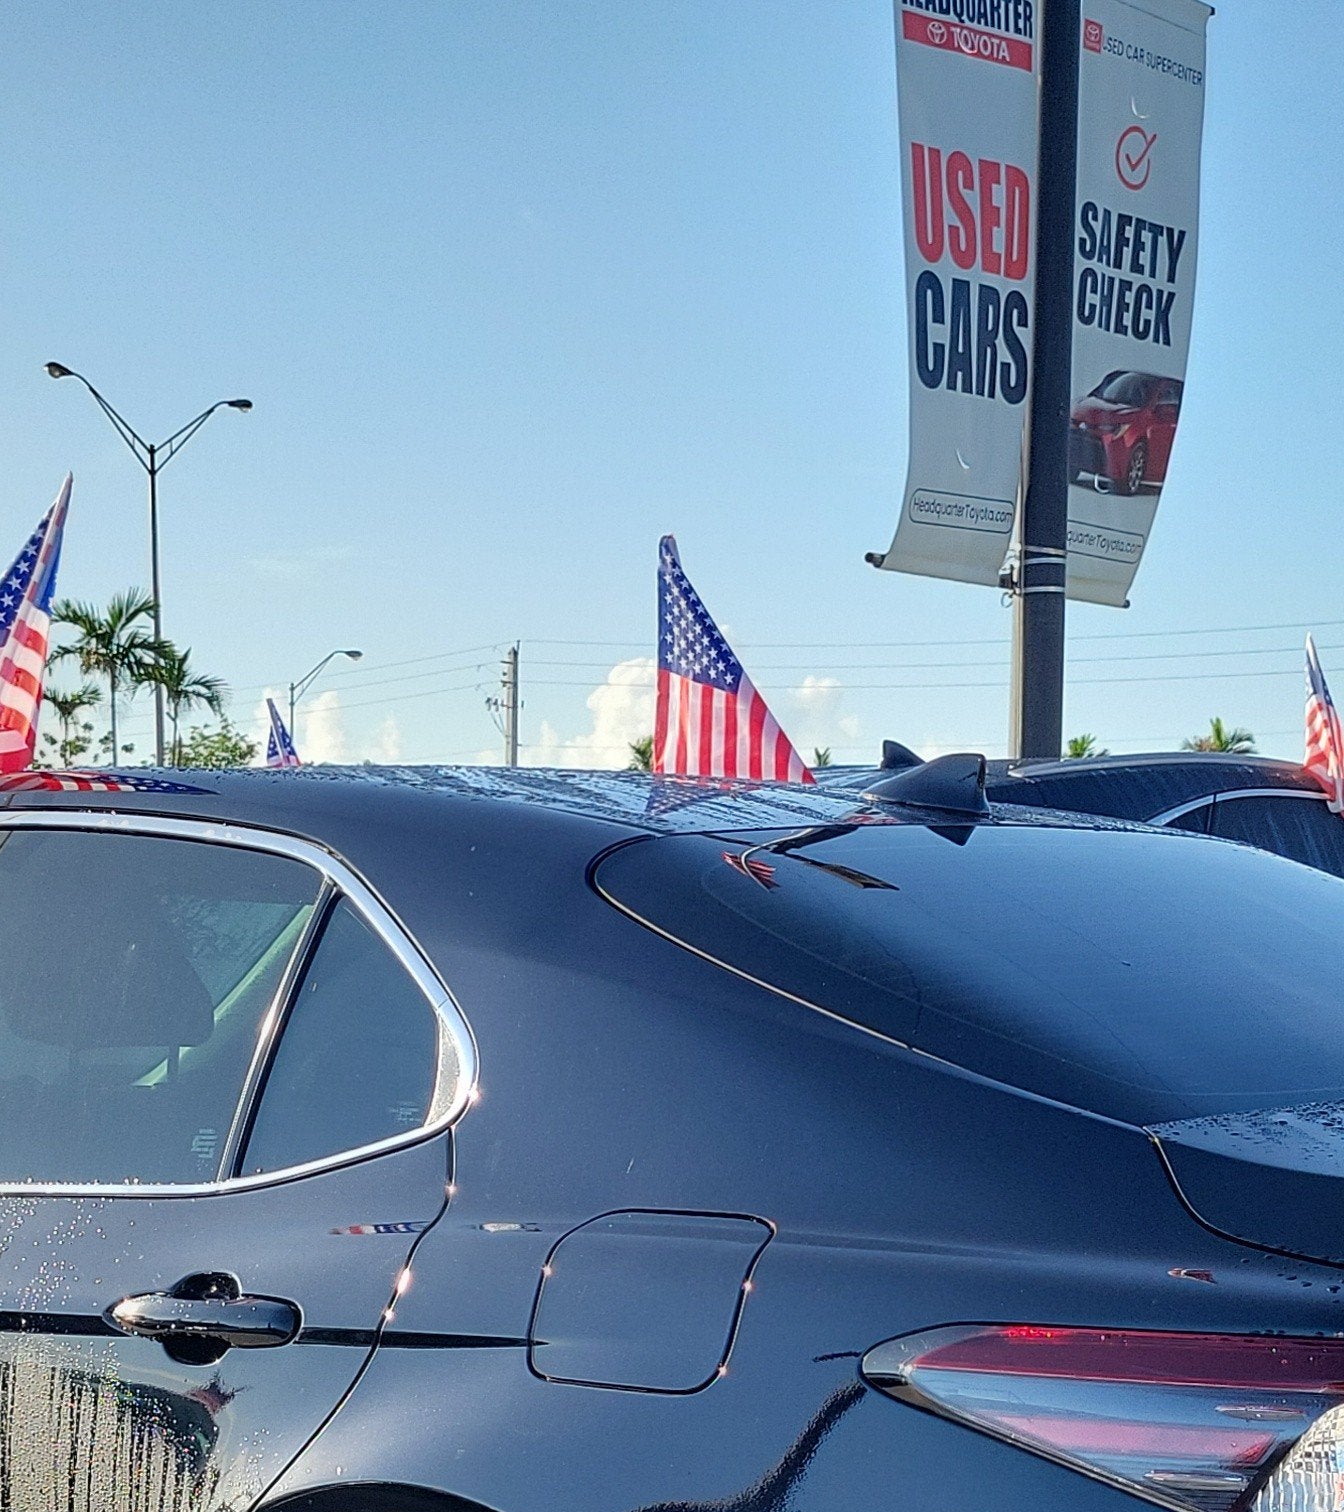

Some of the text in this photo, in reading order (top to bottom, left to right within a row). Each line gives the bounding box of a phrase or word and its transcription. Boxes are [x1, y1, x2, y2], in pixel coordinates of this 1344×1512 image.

[903, 0, 1033, 39] QUARTER
[950, 26, 1010, 62] TOYOTA
[1126, 44, 1144, 64] CAR
[1146, 51, 1202, 86] SUPERCENTER
[911, 142, 1030, 281] USED
[1078, 201, 1187, 284] SAFETY
[915, 270, 1029, 404] CARS
[1077, 267, 1176, 347] CHECK
[913, 498, 1013, 524] HeadquarterToyota.com
